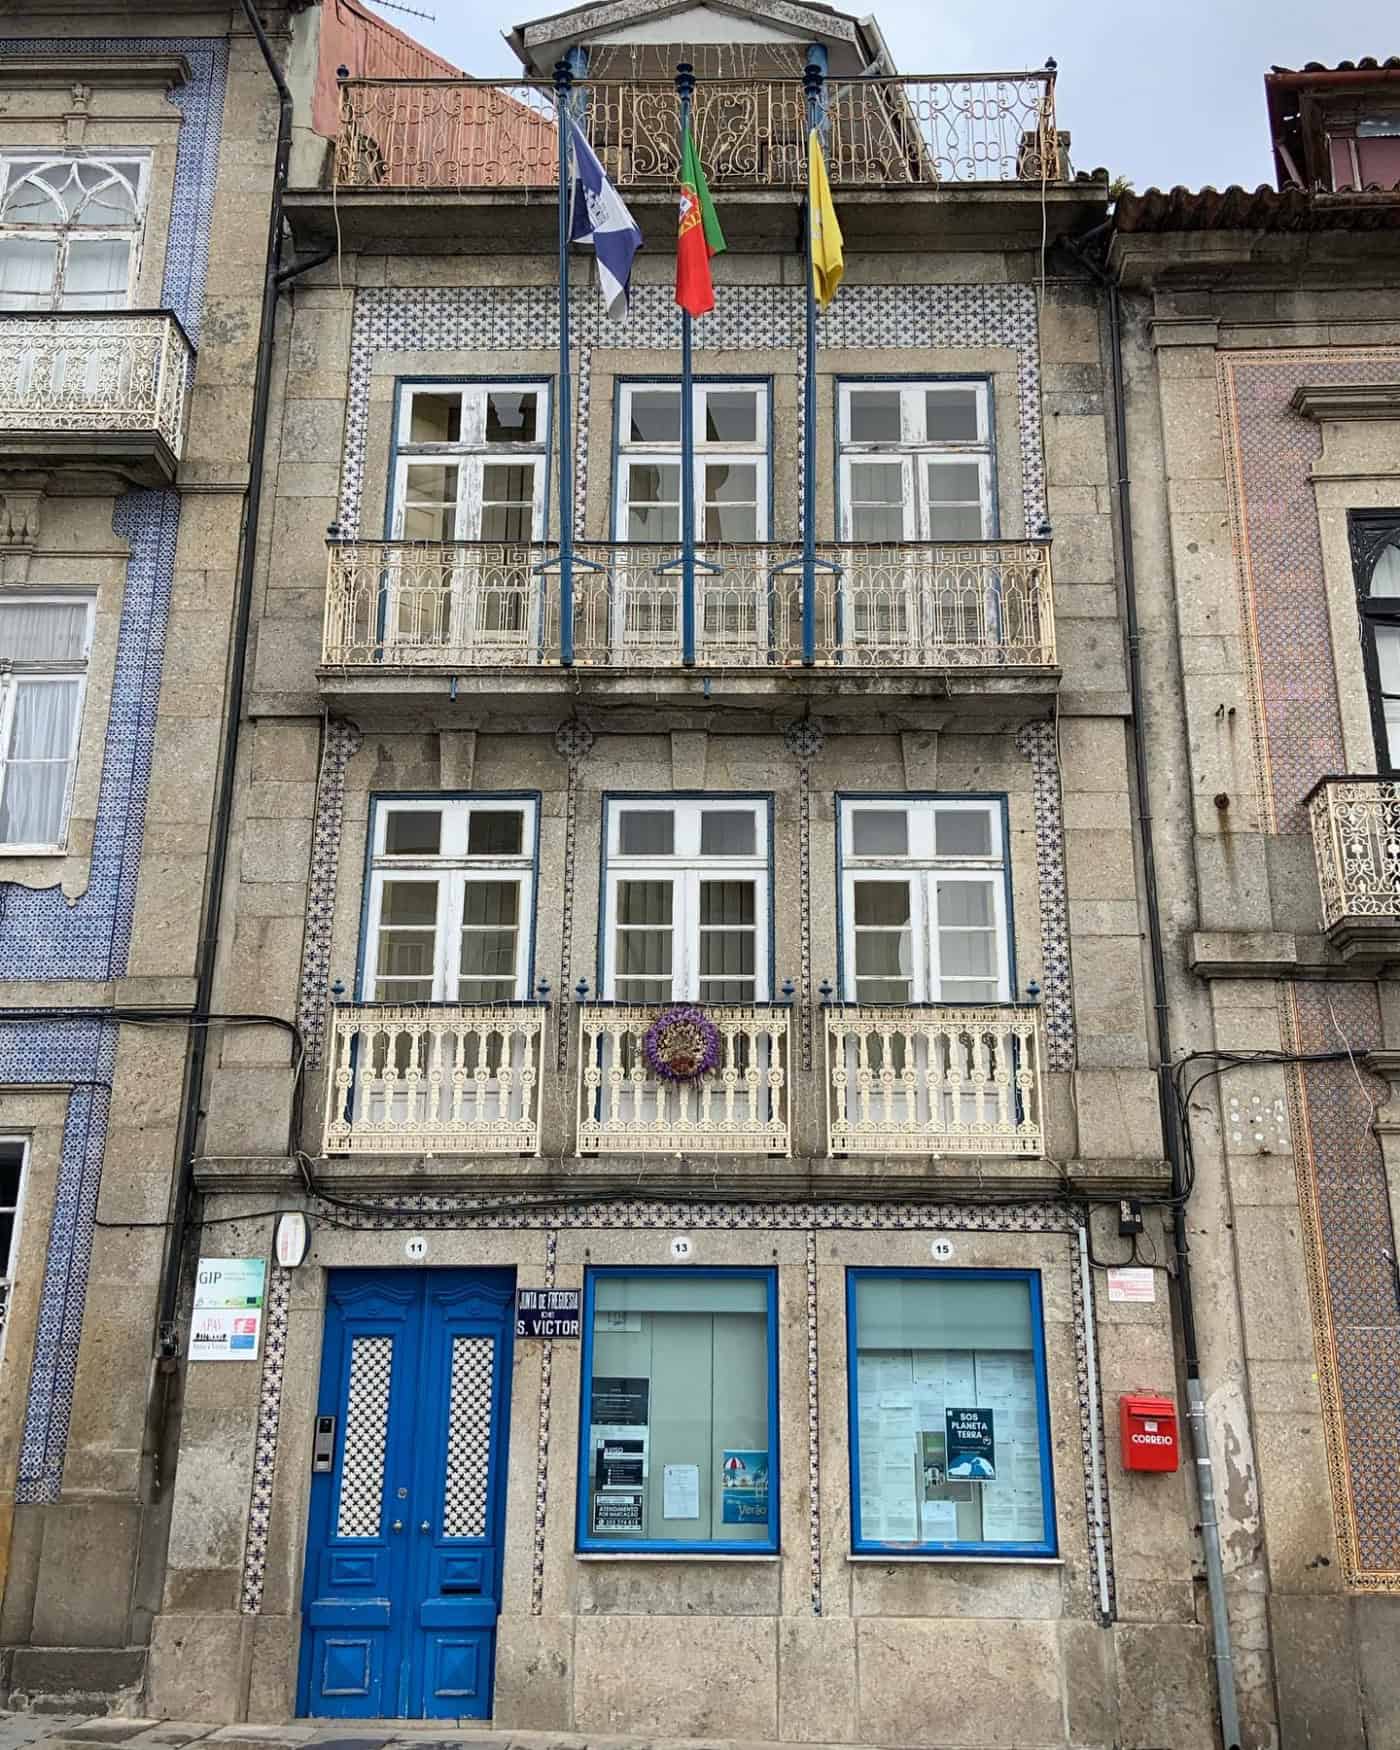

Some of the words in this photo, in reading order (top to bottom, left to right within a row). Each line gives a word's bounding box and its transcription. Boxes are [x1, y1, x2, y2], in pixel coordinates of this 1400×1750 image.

[411, 1243, 422, 1253] 11
[675, 1243, 688, 1253] 13
[936, 1244, 949, 1254] 15
[199, 1271, 222, 1285] GIP
[538, 1293, 547, 1310] DE
[516, 1319, 529, 1336] S.
[532, 1319, 579, 1336] VICTOR
[960, 1413, 979, 1421] SOS
[951, 1421, 988, 1431] PLANETA
[957, 1430, 983, 1439] TERRA
[1131, 1433, 1174, 1446] CORREIO
